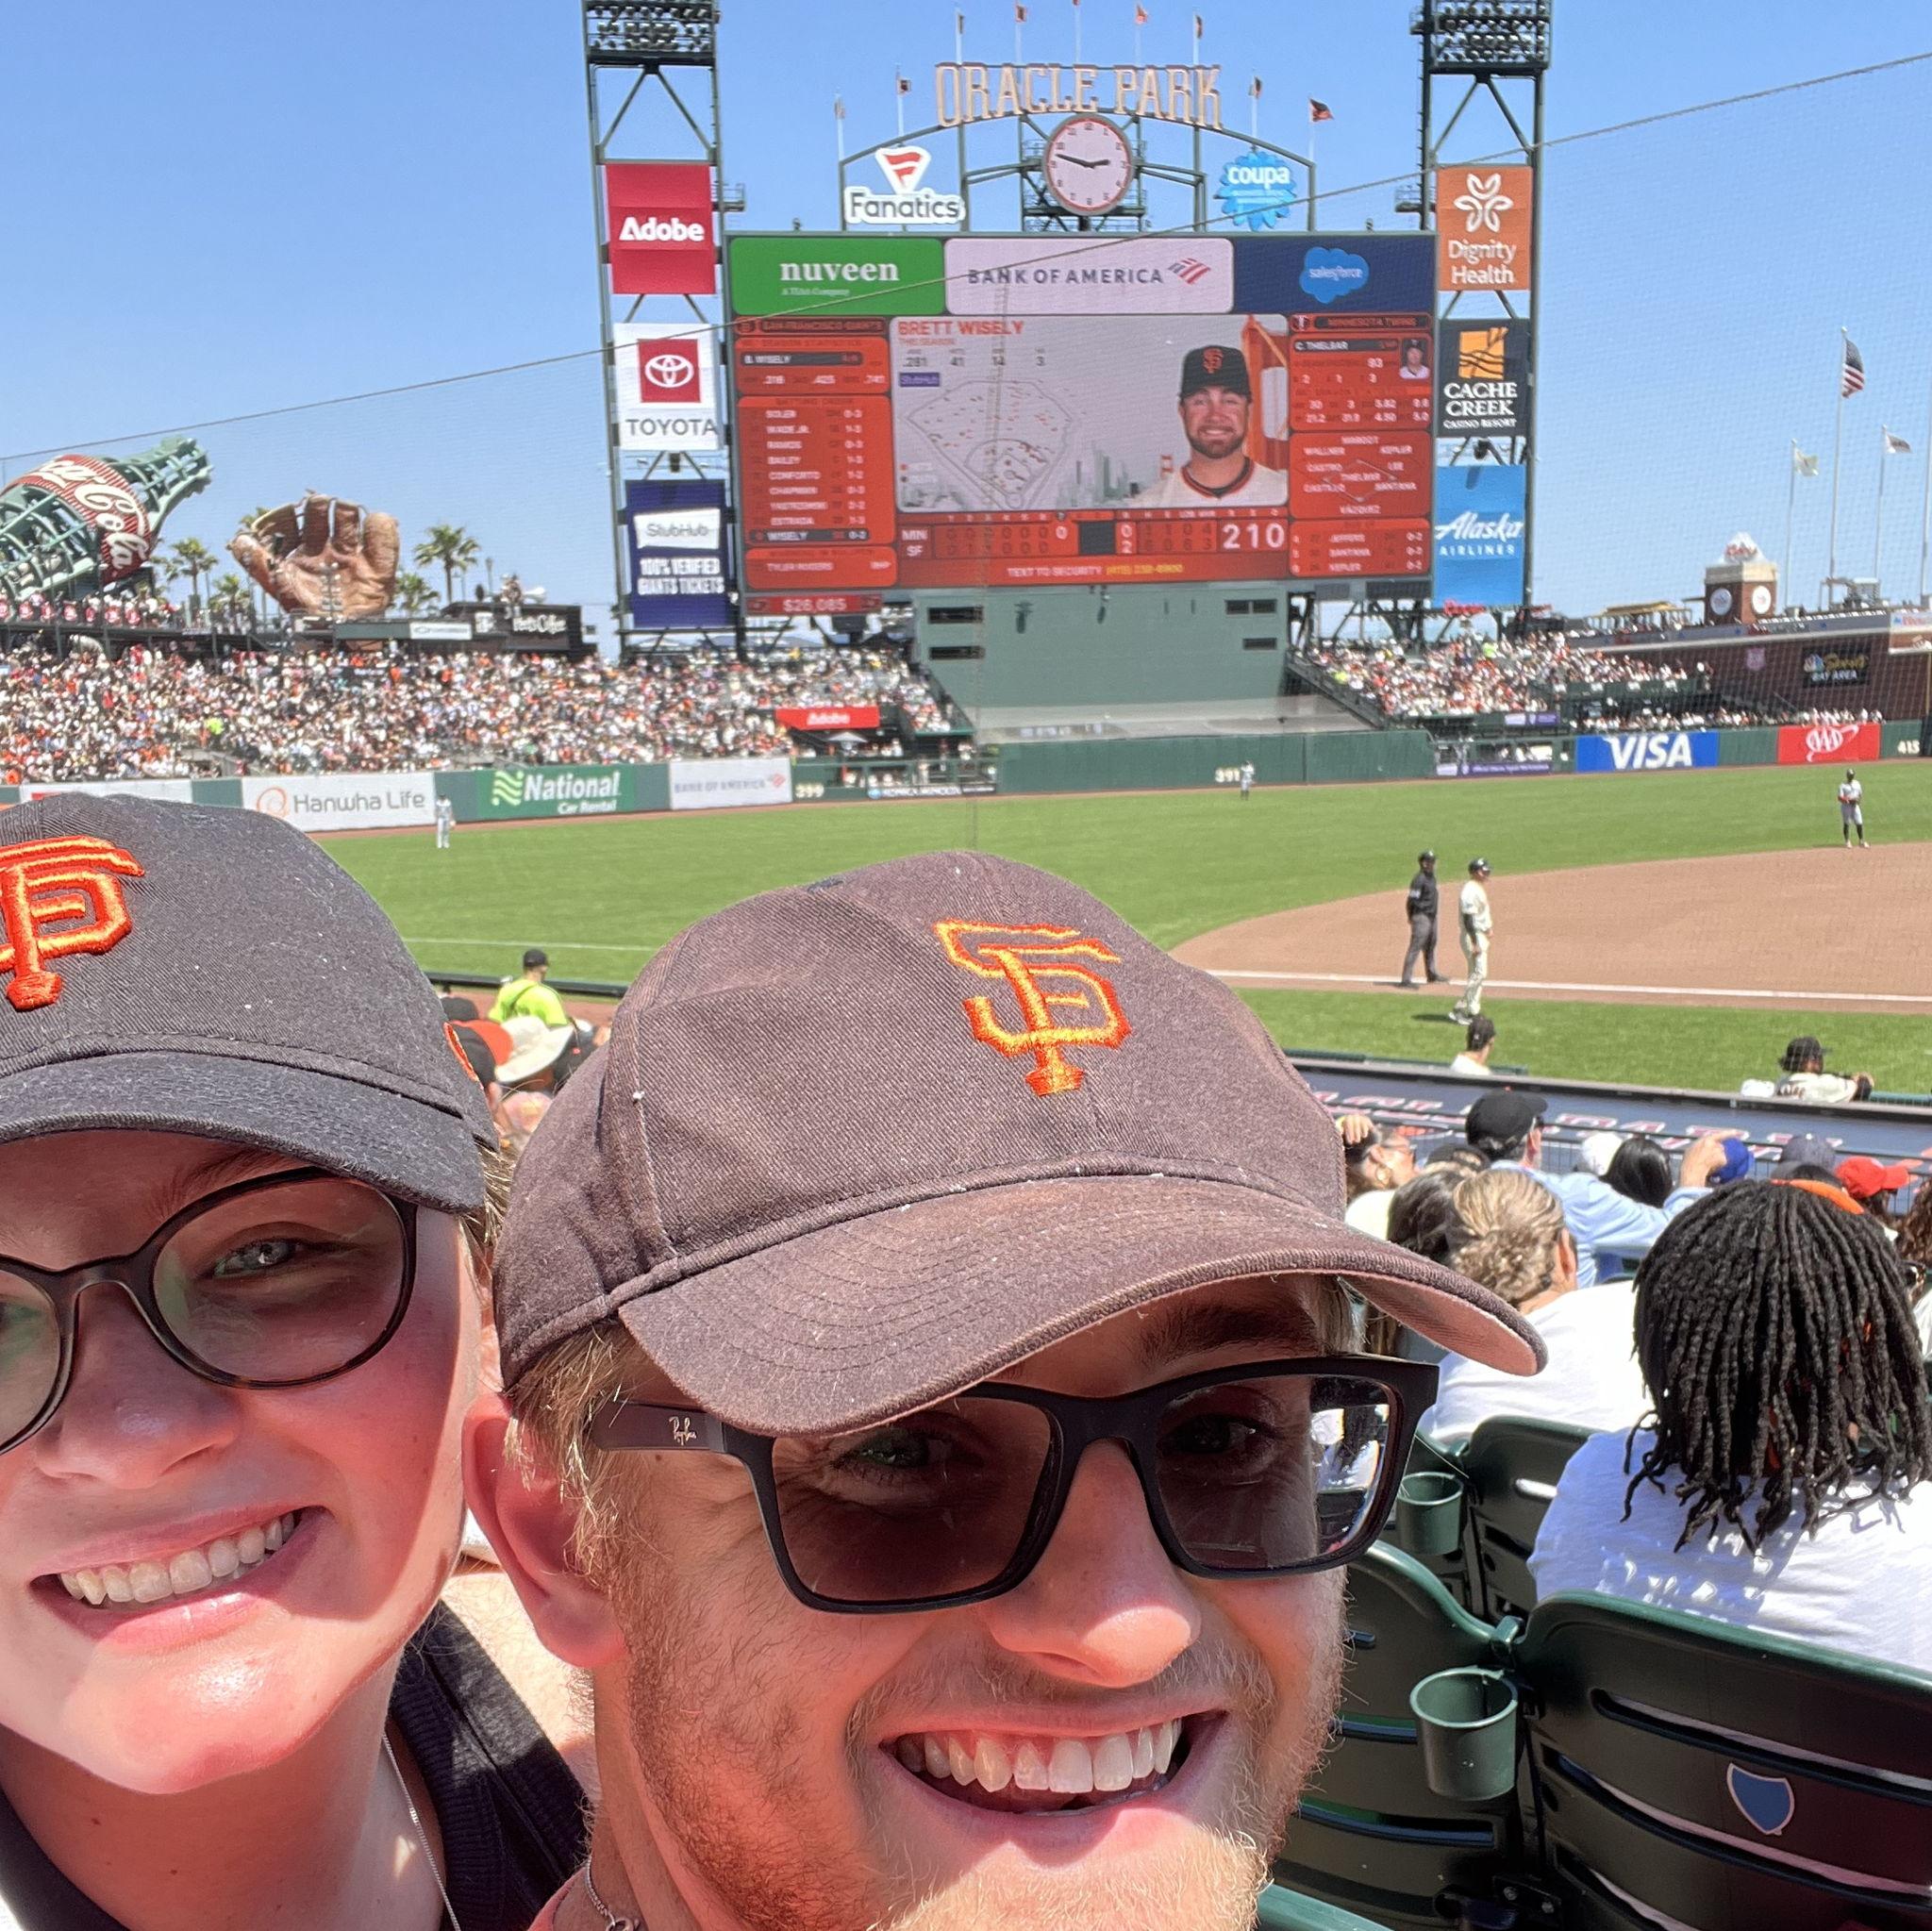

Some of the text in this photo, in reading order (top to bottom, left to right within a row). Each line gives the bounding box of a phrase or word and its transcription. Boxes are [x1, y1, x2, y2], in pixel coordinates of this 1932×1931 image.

[936, 62, 1224, 131] ORACLE PARK
[1228, 166, 1291, 191] coupa
[850, 191, 960, 219] Fanatics
[619, 216, 706, 241] Adobe
[1448, 239, 1517, 264] Dignity
[780, 260, 900, 281] nuveen
[968, 269, 1164, 284] BANK OF AMERICA
[1309, 265, 1363, 282] salesforce
[1451, 265, 1515, 285] Health
[898, 321, 1024, 336] BRETT WISELY
[756, 355, 791, 364] WISELY
[1443, 381, 1518, 399] CACHE
[1445, 400, 1515, 417] CREEK
[625, 418, 718, 436] TOYOTA
[1443, 418, 1518, 430] CASINO RESORT
[645, 523, 709, 539] StubHub
[902, 529, 928, 541] MIN
[1055, 525, 1068, 540] 0
[1434, 510, 1525, 543] Alaska
[906, 545, 924, 557] SF
[1439, 543, 1516, 557] AIRLINES
[1603, 733, 1693, 770] VISA
[1897, 741, 1921, 755] 415
[524, 771, 619, 801] National
[293, 790, 425, 815] Hanwha Life
[557, 800, 617, 814] Car Rental
[932, 918, 1132, 1097] SF
